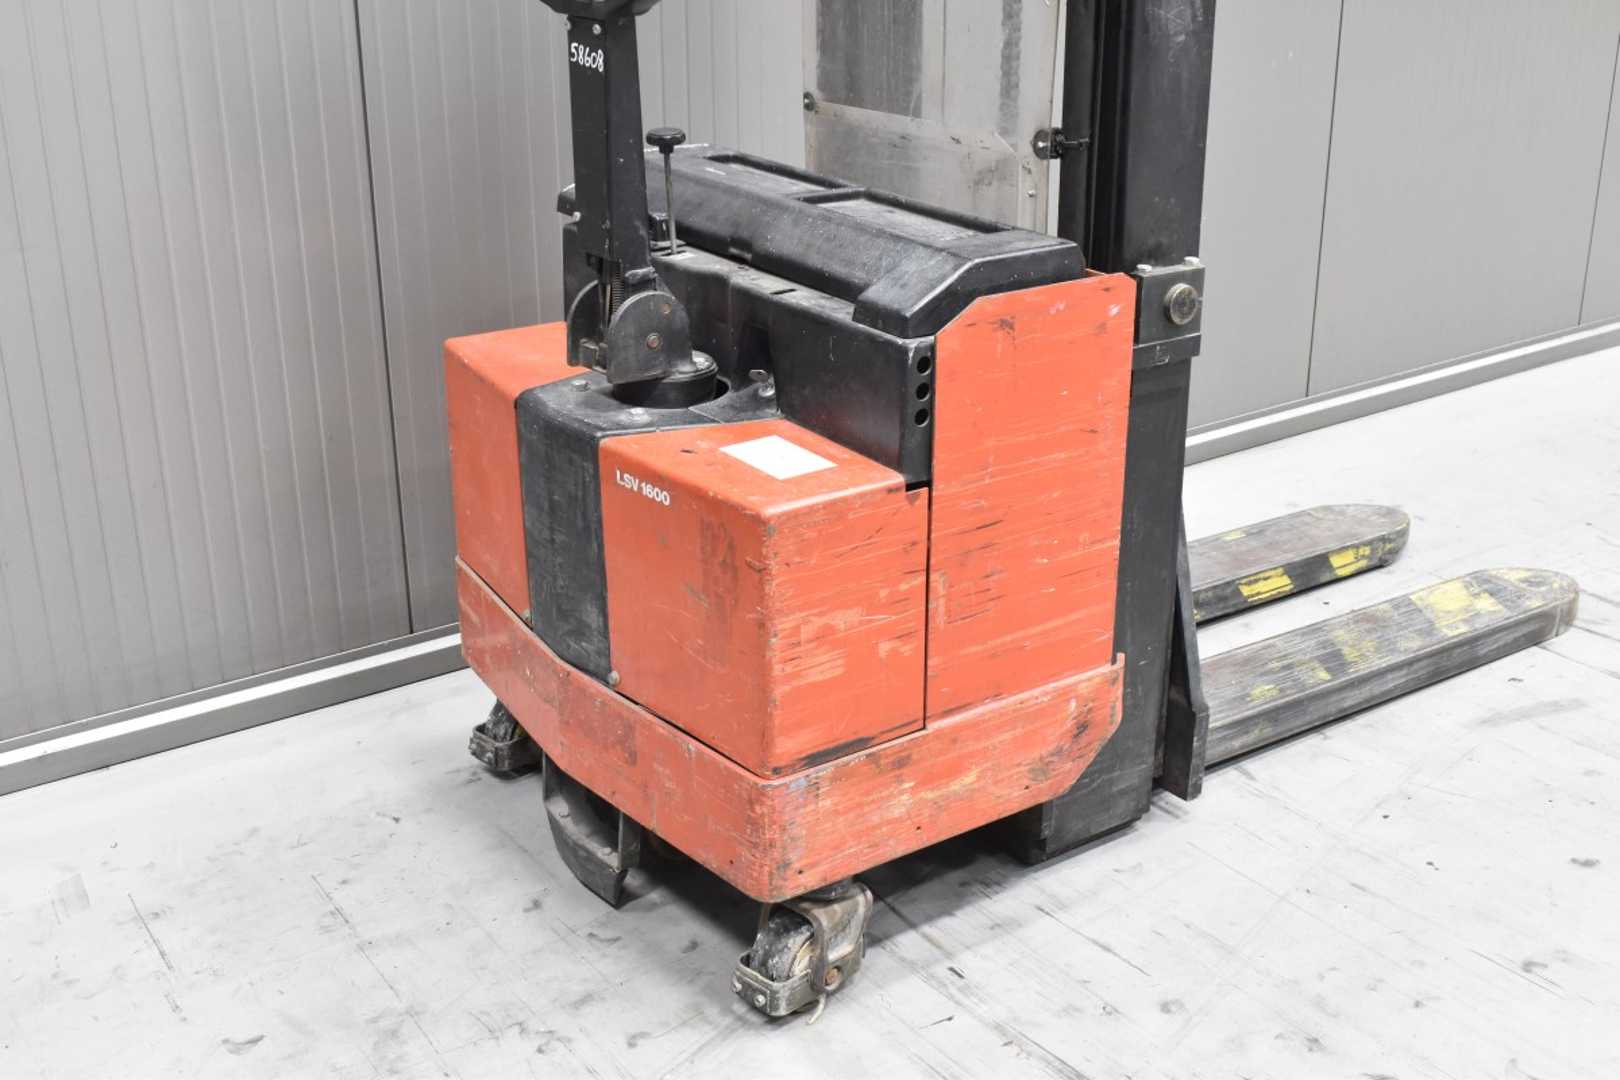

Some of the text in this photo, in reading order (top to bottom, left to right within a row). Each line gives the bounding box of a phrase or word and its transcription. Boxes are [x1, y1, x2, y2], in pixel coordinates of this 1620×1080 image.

[570, 42, 604, 72] 58608
[616, 469, 671, 506] LSV 1600
